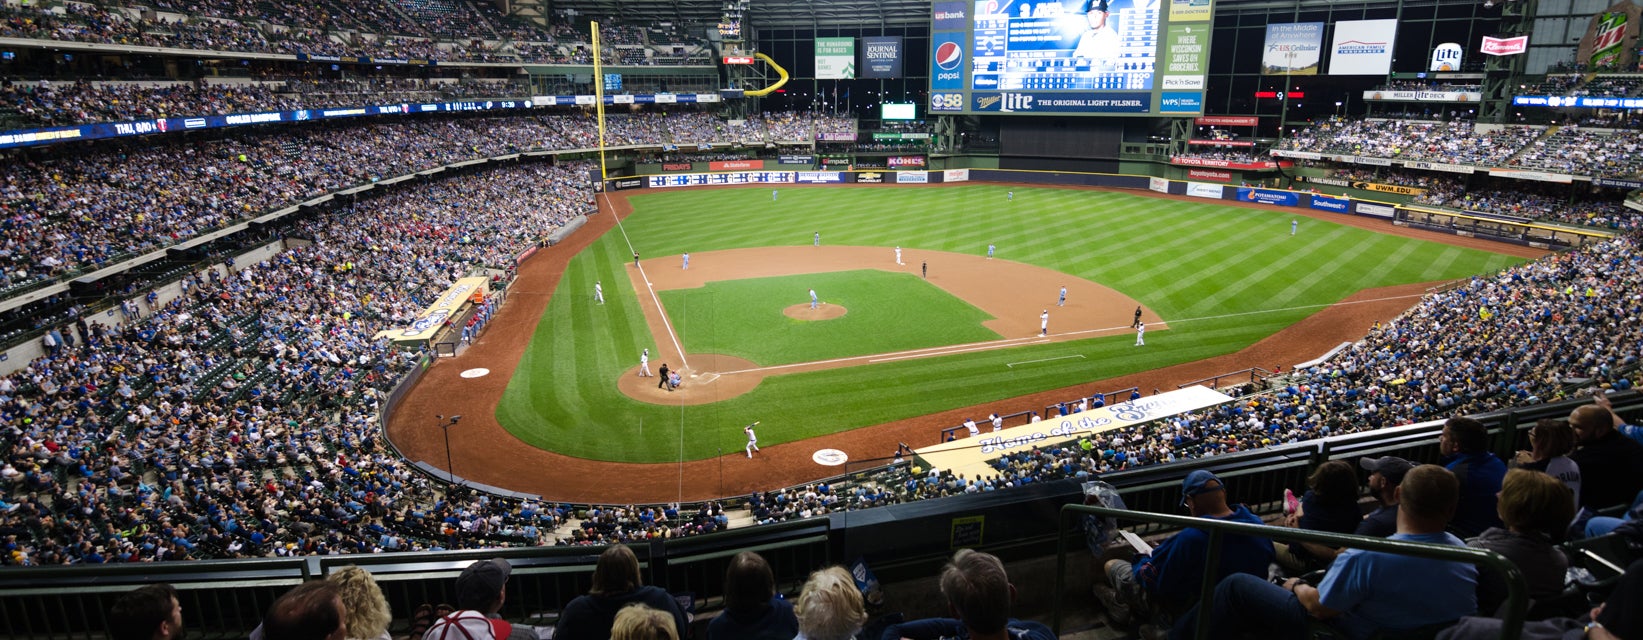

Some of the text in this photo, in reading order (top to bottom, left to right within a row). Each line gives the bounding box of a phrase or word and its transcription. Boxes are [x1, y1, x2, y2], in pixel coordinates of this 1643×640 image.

[1293, 24, 1318, 32] Middle
[1177, 35, 1197, 44] WHERE
[1280, 31, 1316, 40] Anywhere
[867, 45, 897, 53] JOURNAL
[1171, 44, 1202, 53] WISCONSIN
[1291, 44, 1318, 52] Cellular
[1172, 54, 1198, 63] SAVES ON
[1436, 48, 1459, 62] Lite
[937, 72, 960, 81] pepsi
[1414, 89, 1430, 101] Lite
[943, 93, 963, 108] 58
[977, 92, 1033, 113] Miller Lite
[1053, 99, 1086, 107] ORIGINAL
[1087, 99, 1110, 107] LIGHT
[1110, 99, 1143, 107] PILSNER.
[1162, 98, 1178, 106] WPS
[828, 158, 849, 166] impact
[1201, 159, 1229, 167] TERRITORY
[1313, 177, 1349, 187] MILWAUKEE
[1313, 200, 1342, 209] Southwest
[979, 431, 1047, 453] Home
[1051, 420, 1077, 438] of
[1078, 416, 1112, 429] the
